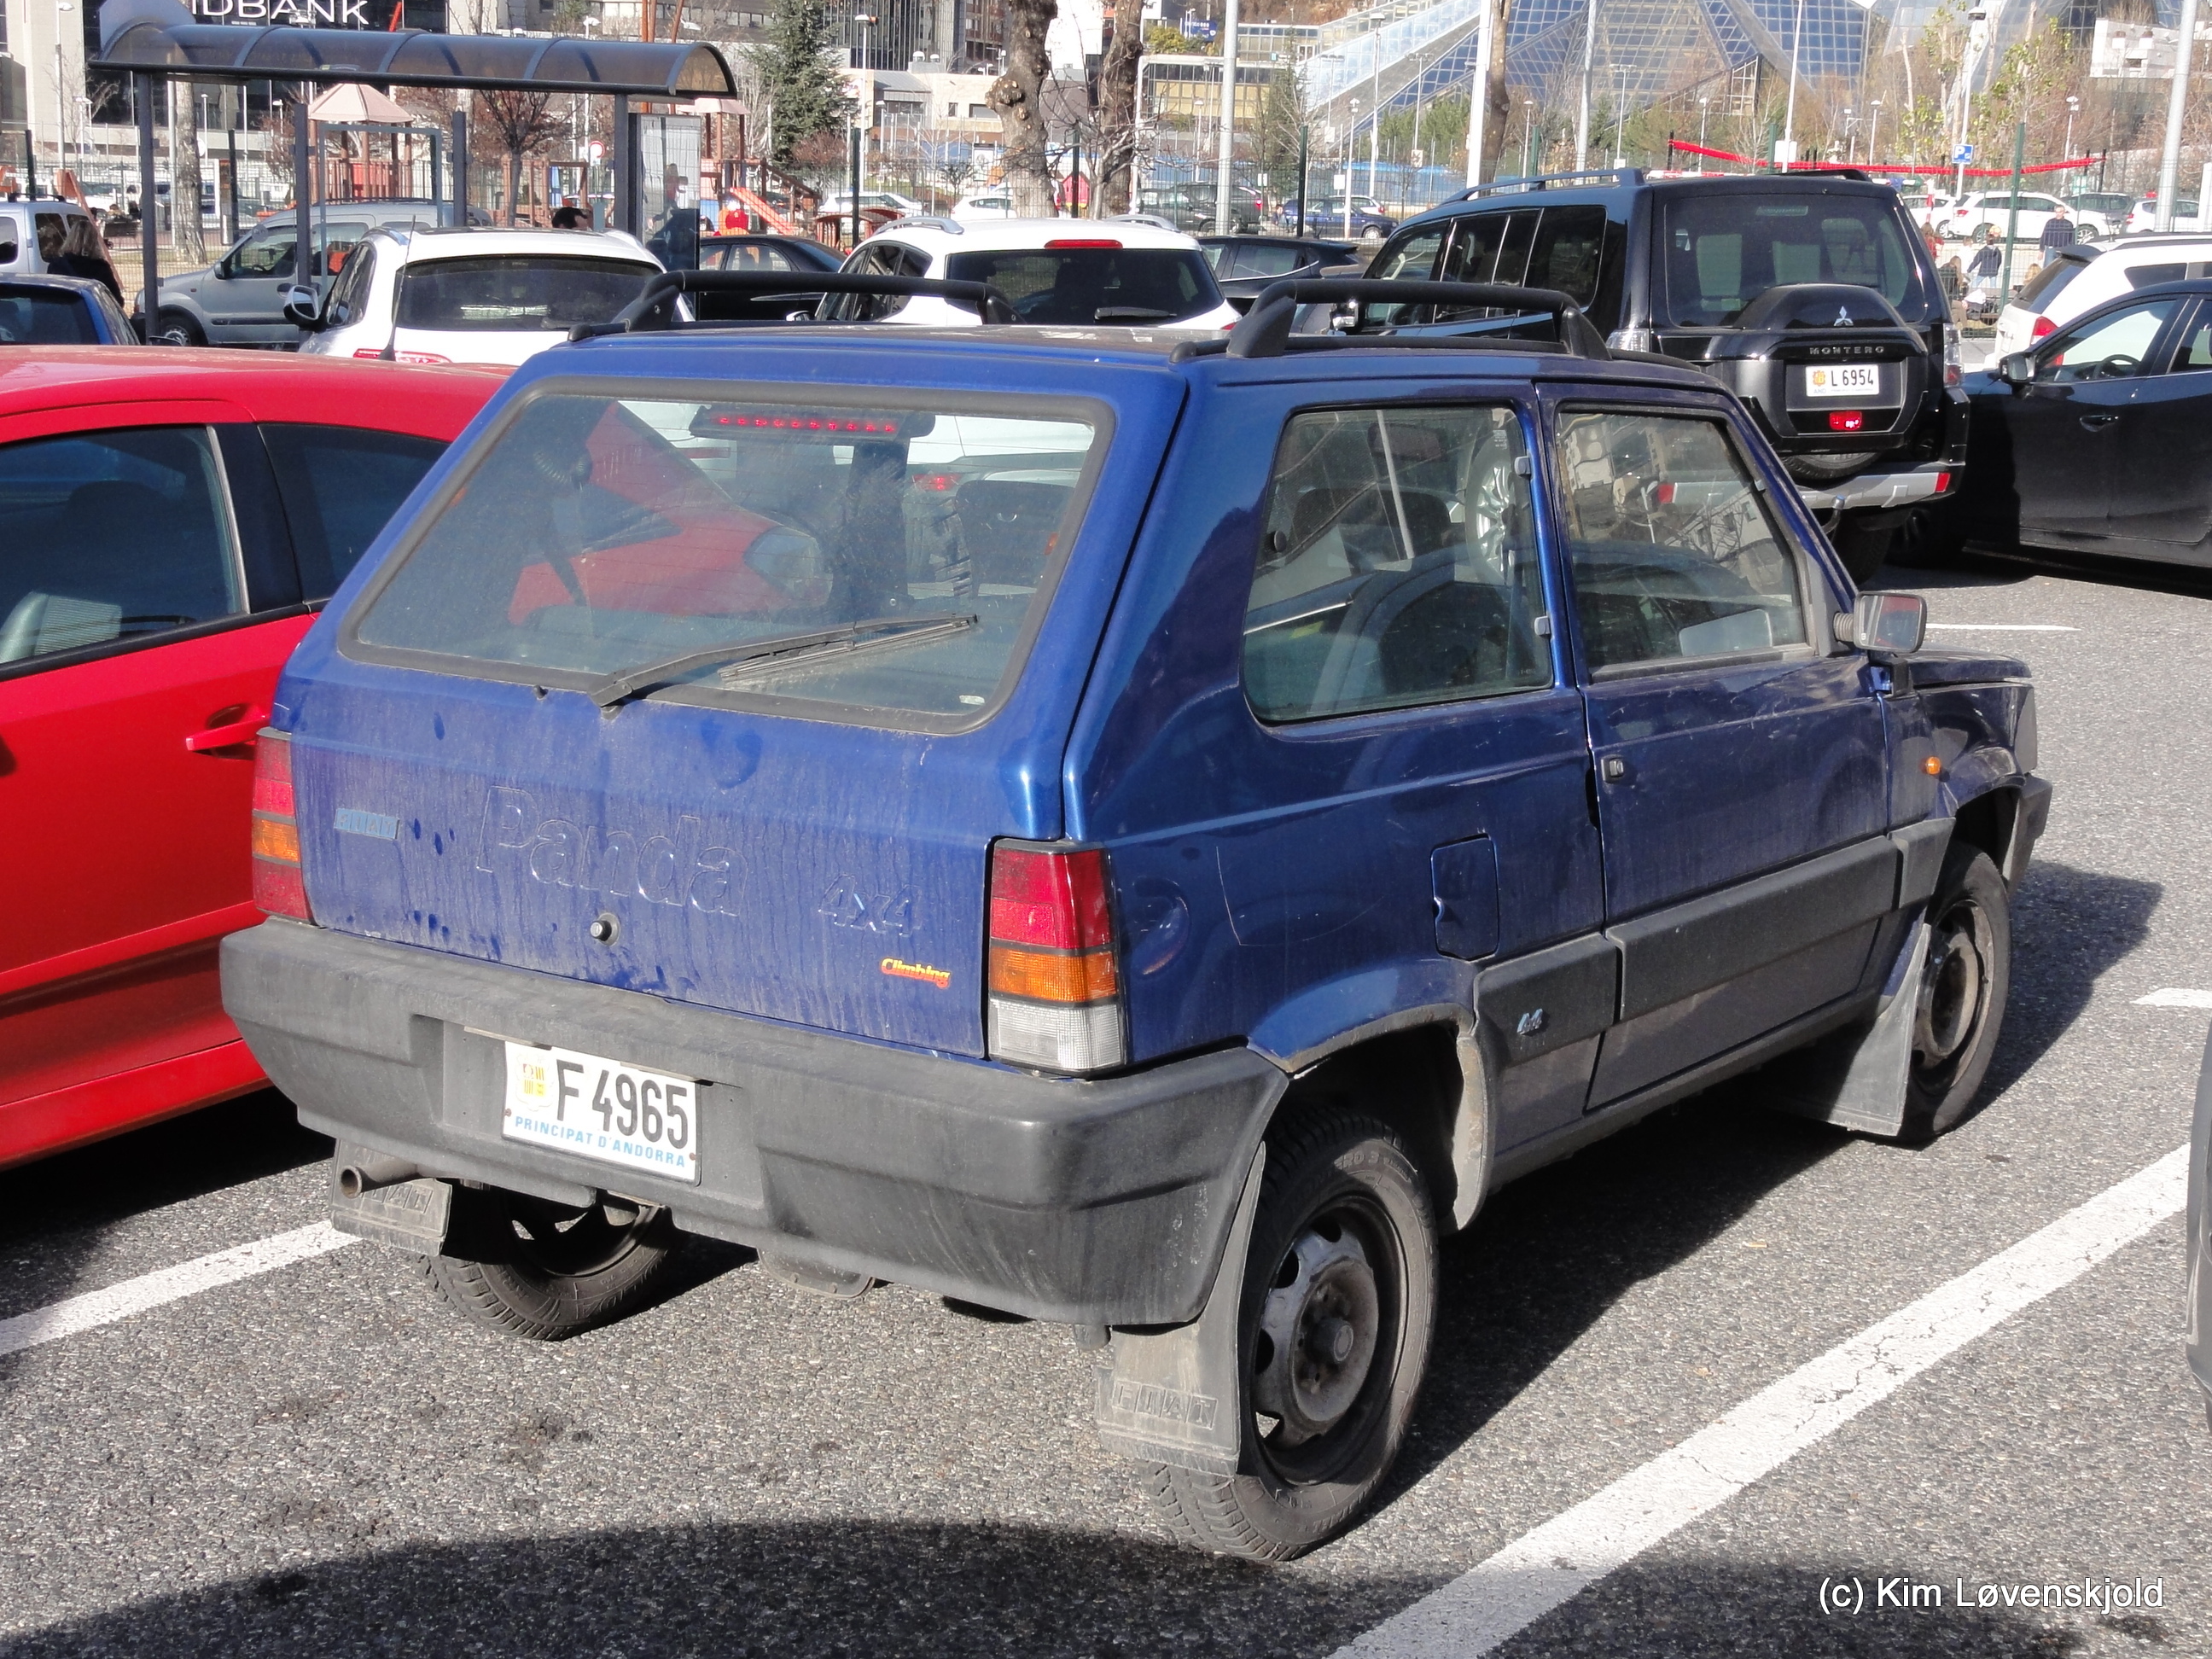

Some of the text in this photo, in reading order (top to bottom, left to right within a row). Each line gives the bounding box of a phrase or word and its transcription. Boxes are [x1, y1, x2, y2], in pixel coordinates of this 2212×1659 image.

[192, 0, 370, 25] DBANK
[1954, 145, 1965, 159] P
[1809, 346, 1884, 355] MONTERO
[1831, 369, 1874, 387] L 6954
[338, 812, 395, 836] FIAT
[475, 785, 748, 917] Panda
[818, 873, 923, 939] 4x4
[881, 957, 952, 990] Climbing
[556, 1058, 689, 1150] F 4965
[515, 1115, 686, 1168] PRINCIPAT D'ANDORRA
[1116, 1384, 1213, 1425] FIAT
